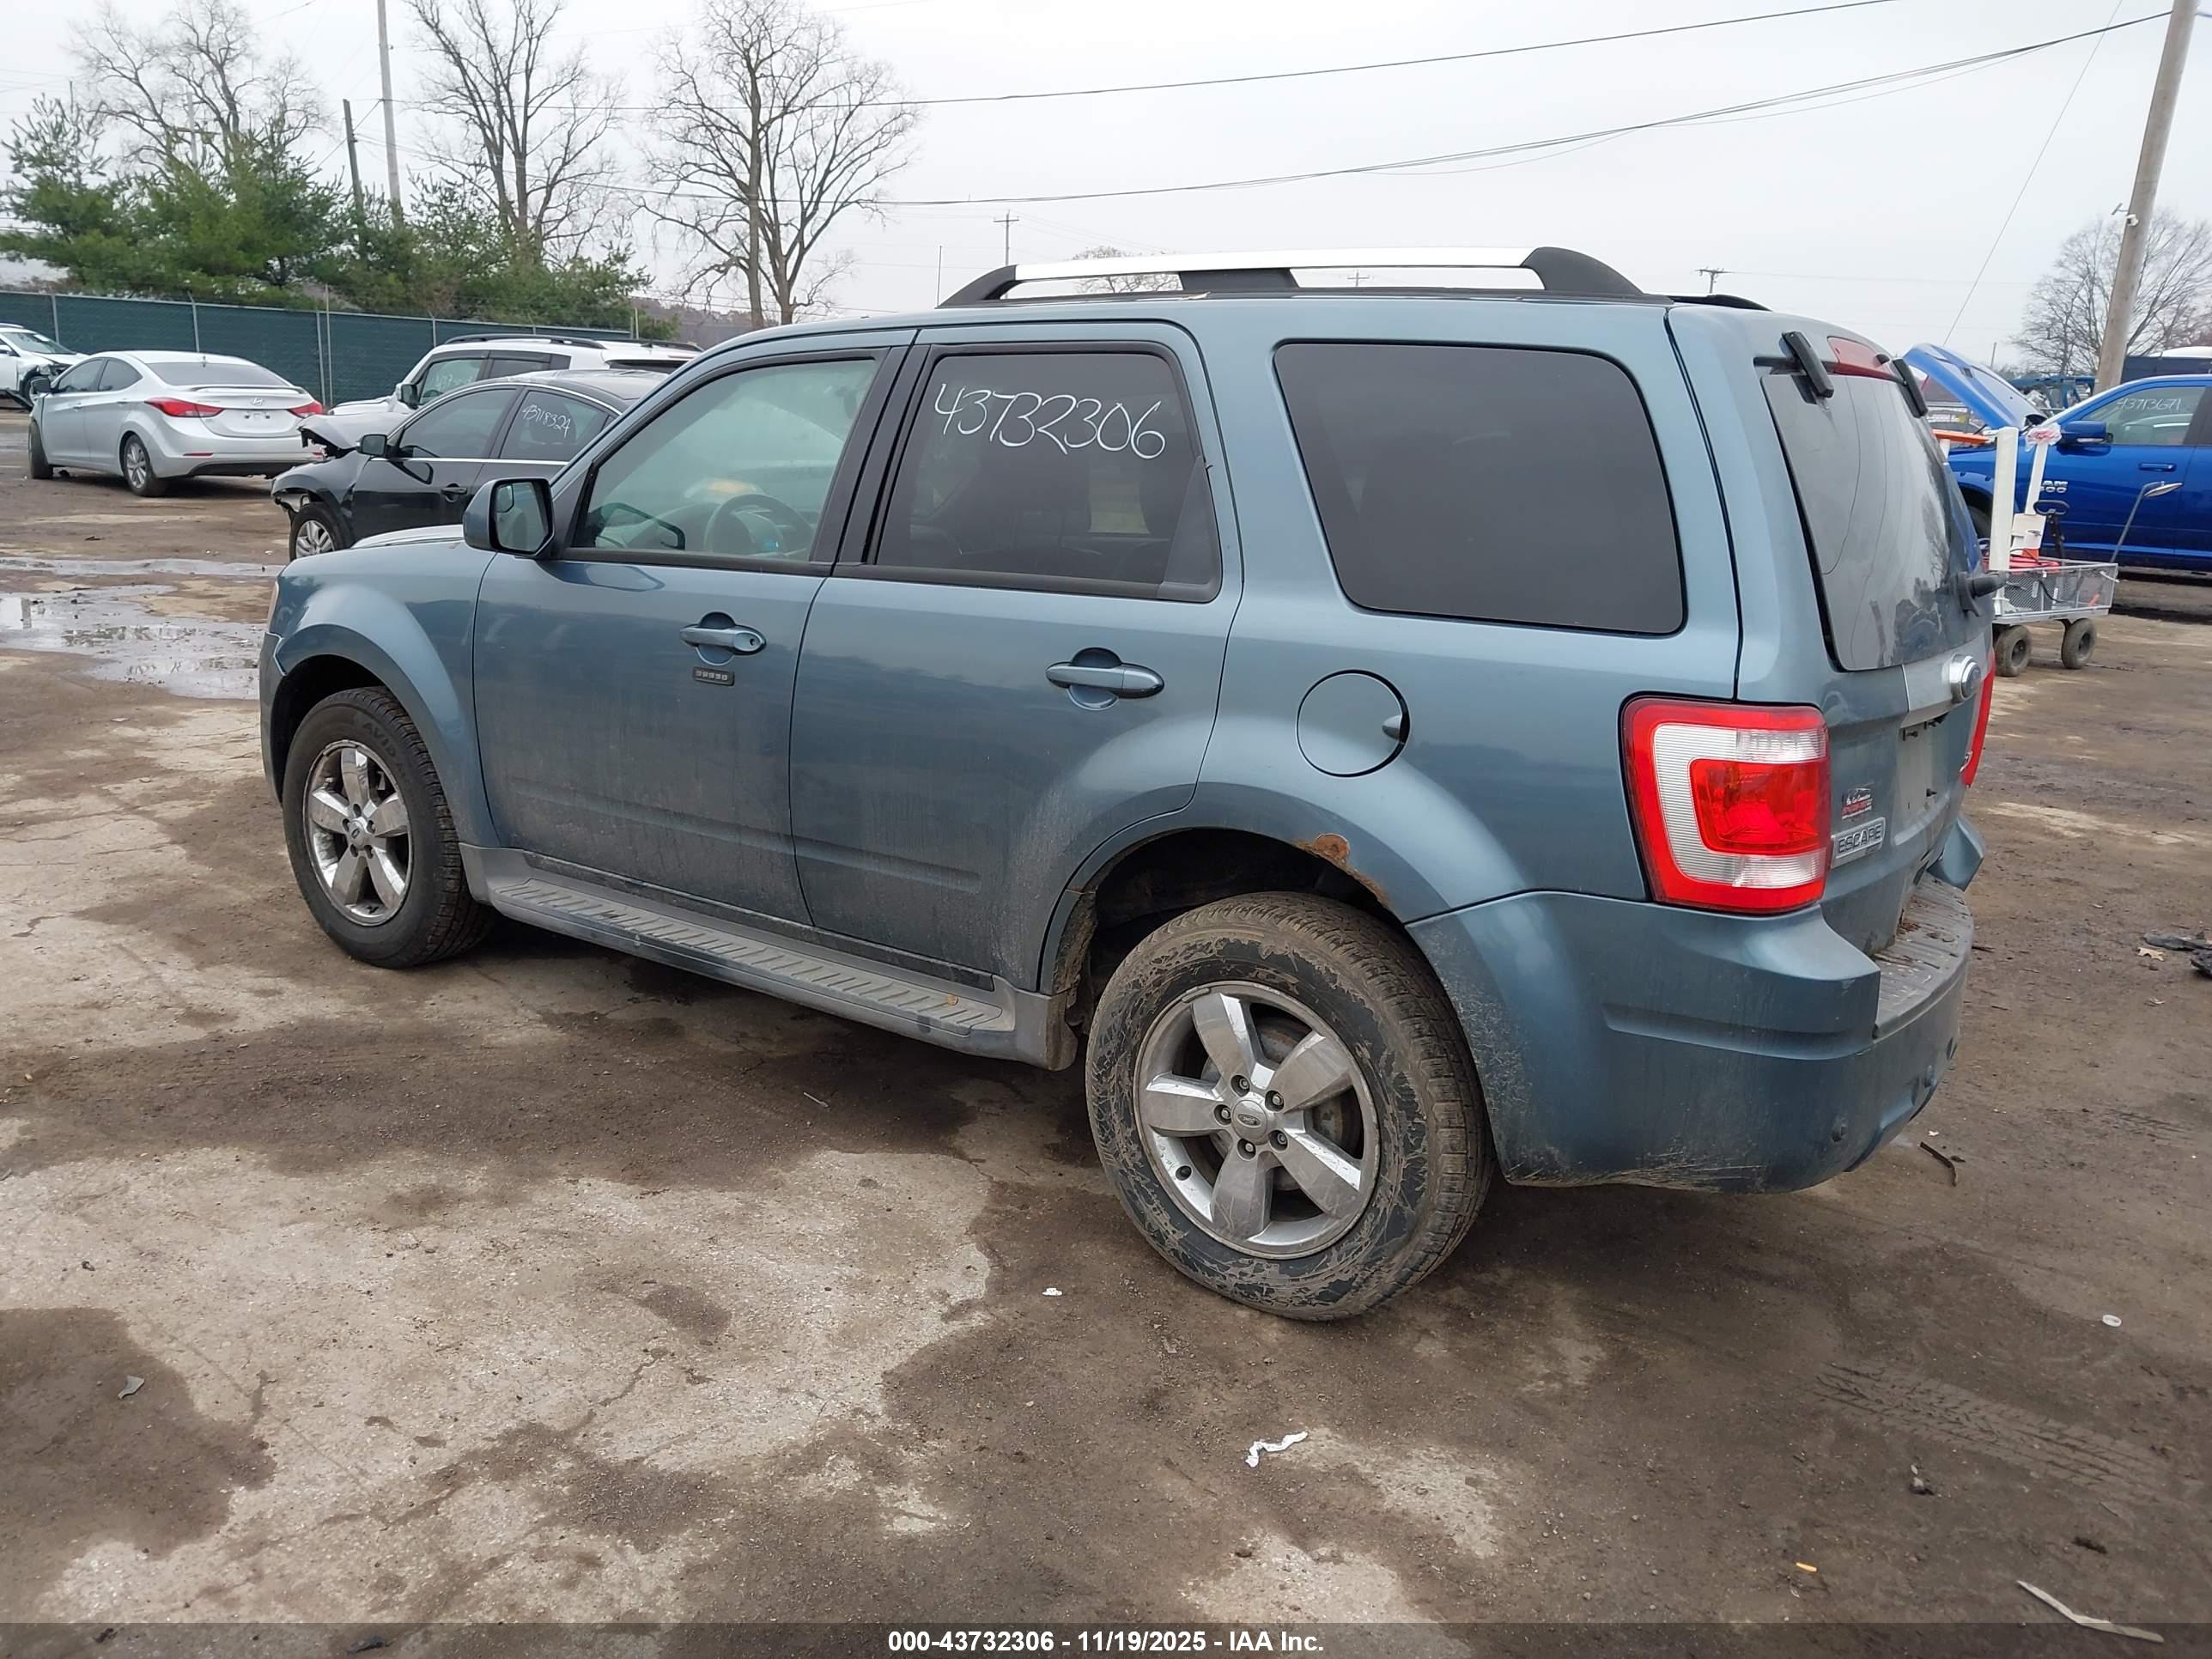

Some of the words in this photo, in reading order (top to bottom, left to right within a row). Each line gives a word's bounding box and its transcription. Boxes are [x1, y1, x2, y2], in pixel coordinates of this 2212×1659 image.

[2117, 398, 2181, 410] 43713671
[934, 383, 1166, 459] 43732306
[1838, 823, 1883, 853] ESCAPE
